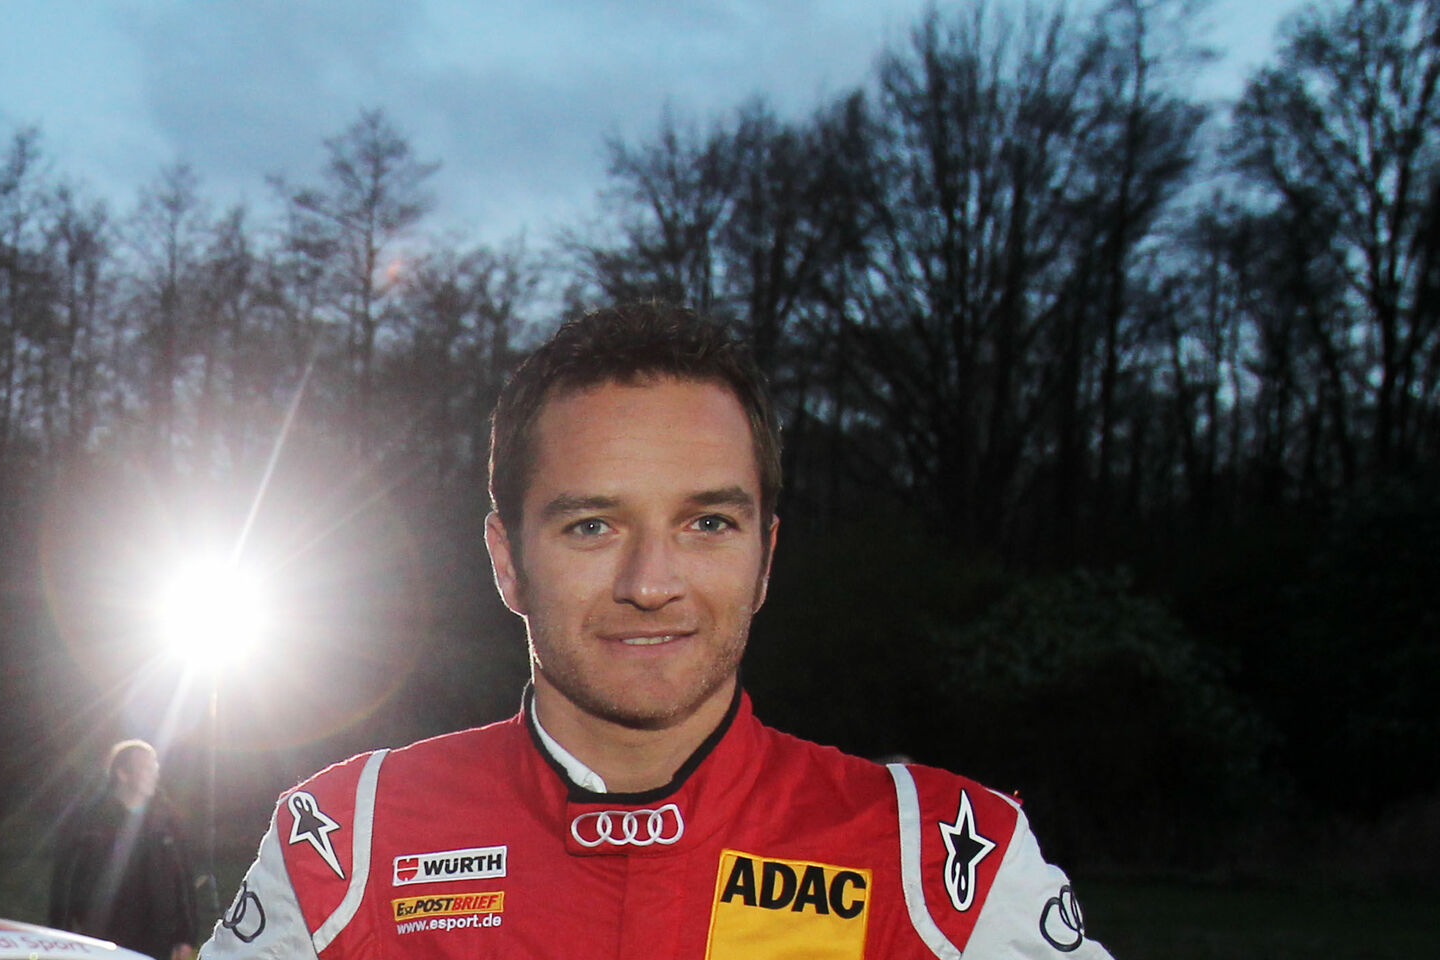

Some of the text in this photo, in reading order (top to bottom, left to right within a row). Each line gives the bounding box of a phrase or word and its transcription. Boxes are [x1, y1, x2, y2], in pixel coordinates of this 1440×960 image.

[720, 856, 867, 920] ADAC
[397, 913, 502, 935] www.esport.de
[21, 936, 93, 954] Sport
